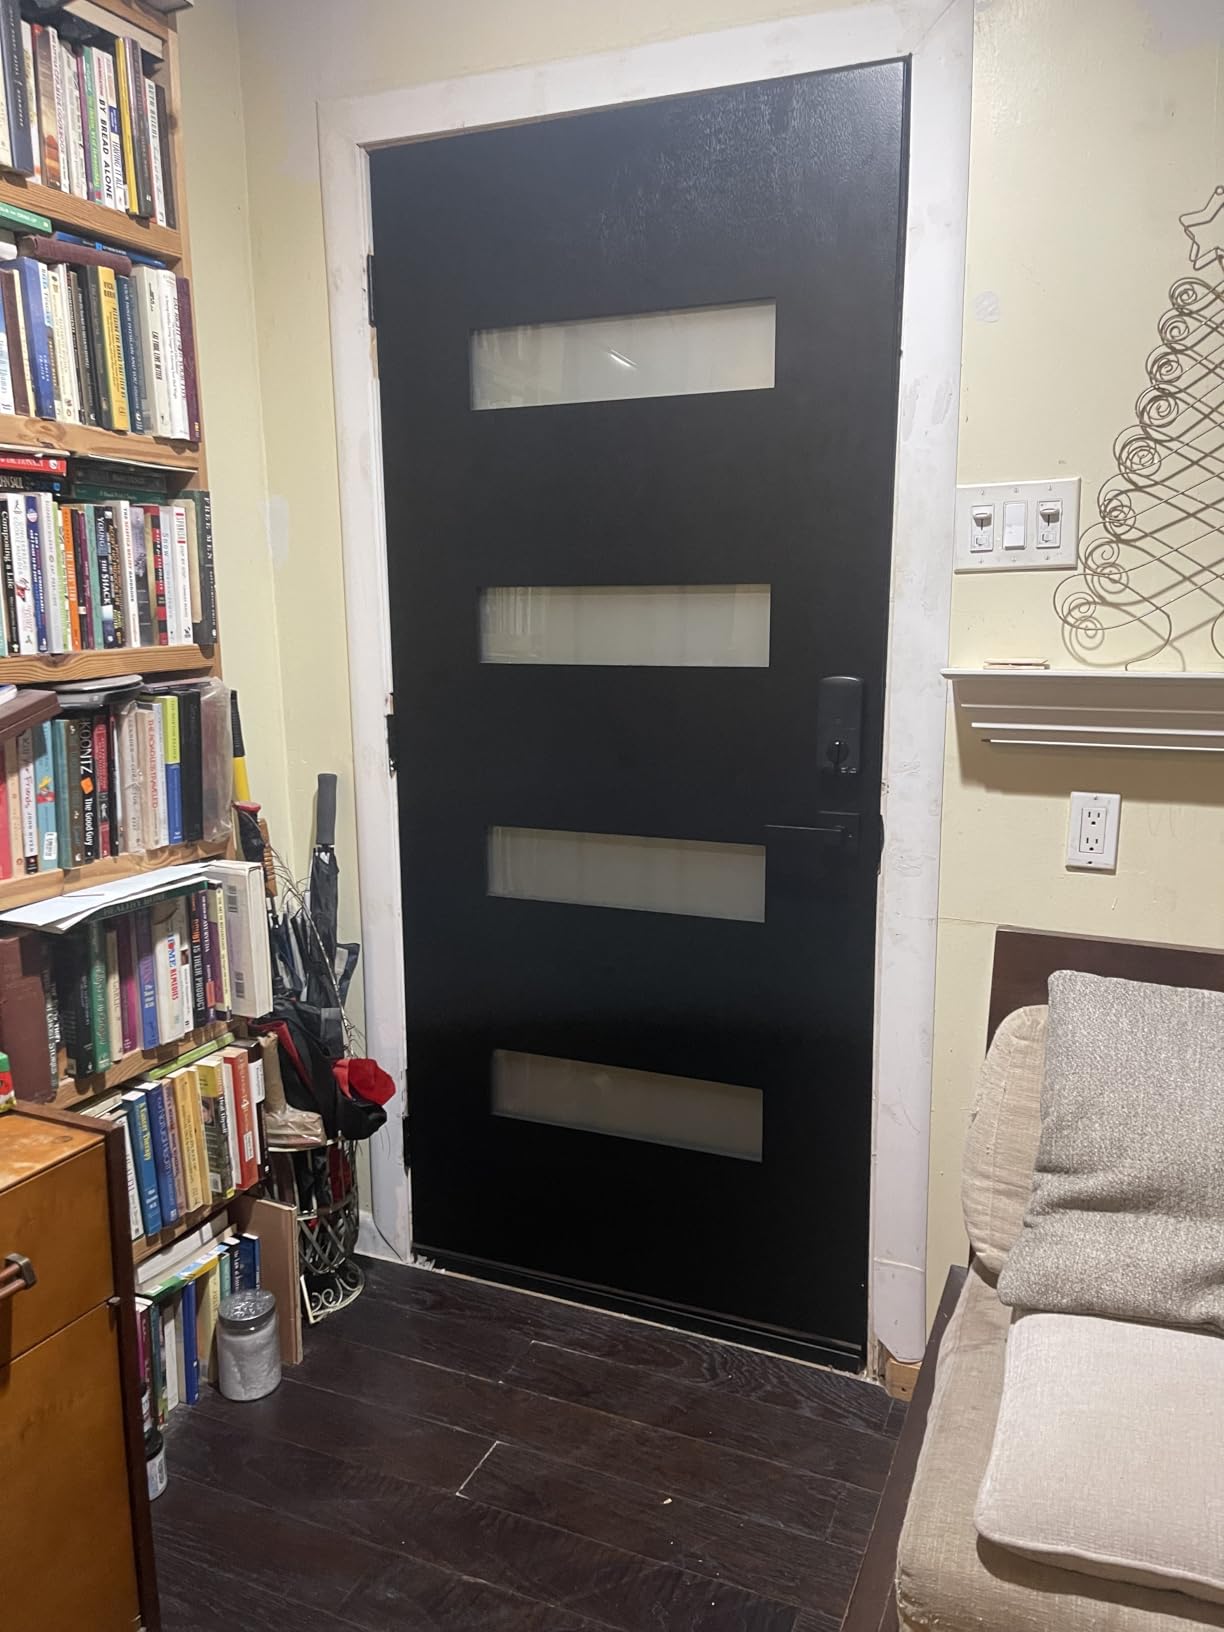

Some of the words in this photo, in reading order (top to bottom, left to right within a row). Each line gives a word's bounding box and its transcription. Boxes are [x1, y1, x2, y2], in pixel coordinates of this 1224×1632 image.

[99, 99, 107, 113] BY
[100, 118, 109, 155] BREAD
[112, 141, 121, 167] HAVING
[104, 160, 113, 200] ALONE
[116, 177, 124, 190] ALL
[112, 307, 120, 332] BLESSING
[154, 363, 163, 380] BETTER
[203, 497, 212, 530] FREE
[1, 510, 12, 562] Composing
[176, 516, 185, 540] SPANISH
[97, 517, 105, 547] YOUNG
[101, 573, 111, 604] SHACK
[6, 572, 14, 589] Life
[147, 719, 155, 733] THE
[79, 721, 93, 775] KOONTZ
[148, 734, 156, 756] ROAD
[150, 770, 159, 809] TRAVELED
[84, 797, 93, 811] The
[84, 812, 93, 831] Good
[83, 832, 94, 846] Guy
[191, 918, 201, 944] DOUBT
[202, 919, 210, 953] AYURVEDA
[167, 934, 177, 967] HOME
[192, 945, 201, 953] IS
[193, 954, 203, 977] THEIR
[170, 968, 179, 1001] REMEDIES
[195, 977, 205, 1011] PRODUCT
[46, 1013, 56, 1040] GHOST
[48, 1042, 57, 1075] STORIES
